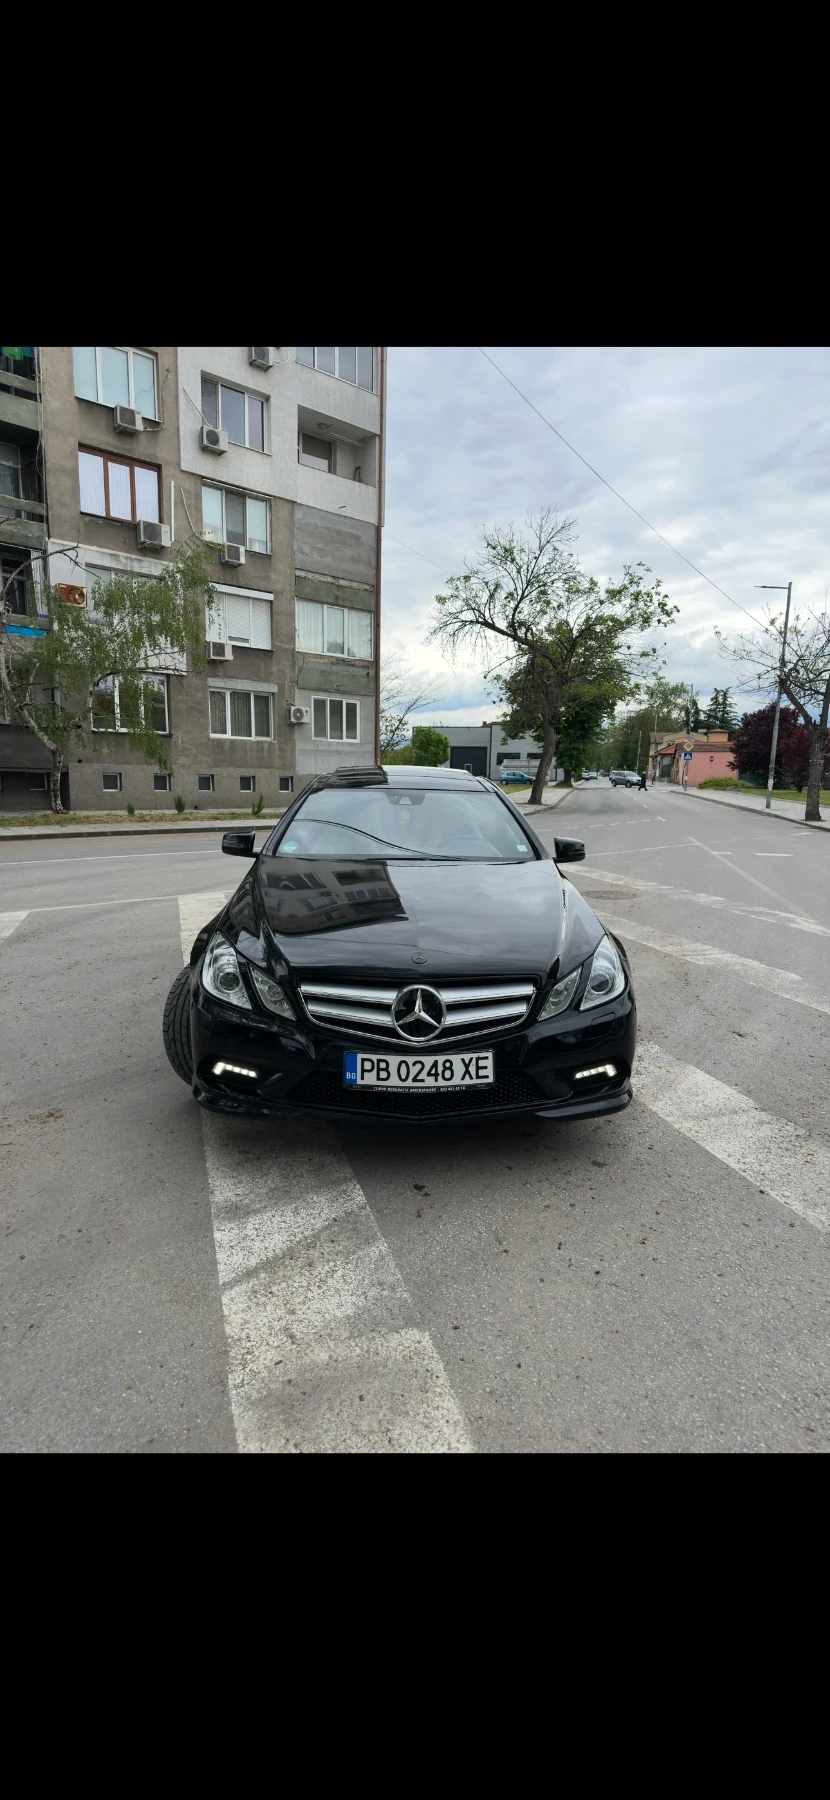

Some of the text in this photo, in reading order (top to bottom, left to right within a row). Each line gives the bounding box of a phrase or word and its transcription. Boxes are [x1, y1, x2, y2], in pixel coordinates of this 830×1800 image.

[346, 1072, 357, 1080] BG
[361, 1056, 489, 1082] PB 0248 XE
